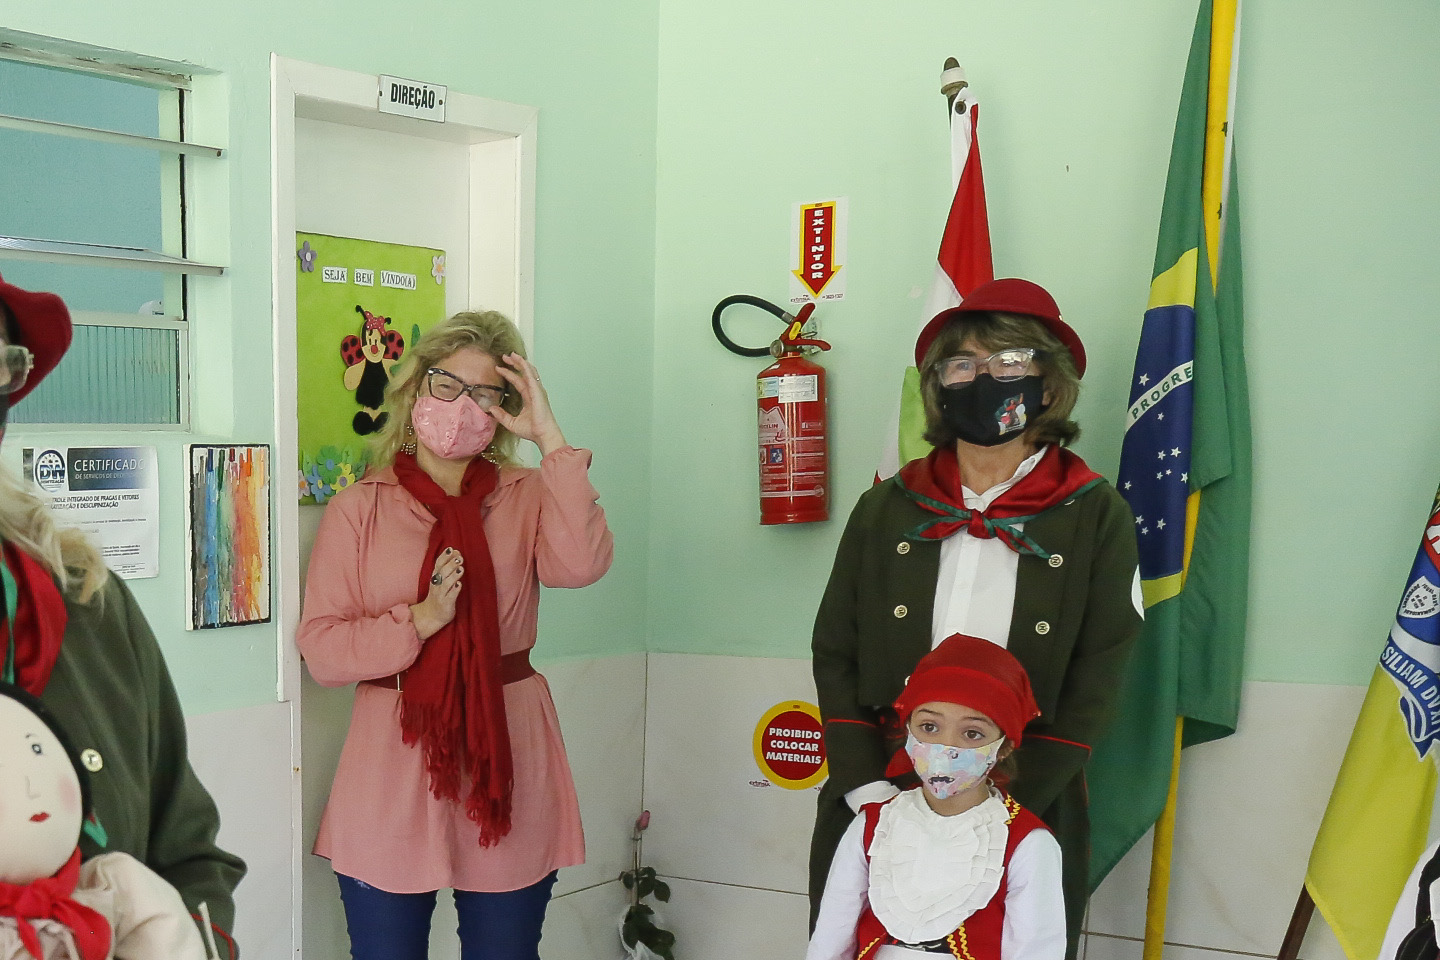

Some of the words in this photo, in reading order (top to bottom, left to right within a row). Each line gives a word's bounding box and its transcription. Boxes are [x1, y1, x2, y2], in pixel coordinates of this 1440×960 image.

[391, 83, 436, 110] DIREÇÃO
[810, 209, 825, 279] EXTINTOR
[324, 269, 347, 282] SEJA
[355, 271, 373, 284] BEM
[381, 271, 416, 289] VINDO(A)
[1131, 366, 1193, 420] PROGRE
[74, 459, 145, 472] CERTIFICADO
[769, 727, 822, 740] PROIBIDO
[770, 740, 819, 752] COLOCAR
[766, 751, 822, 764] MATERIAIS
